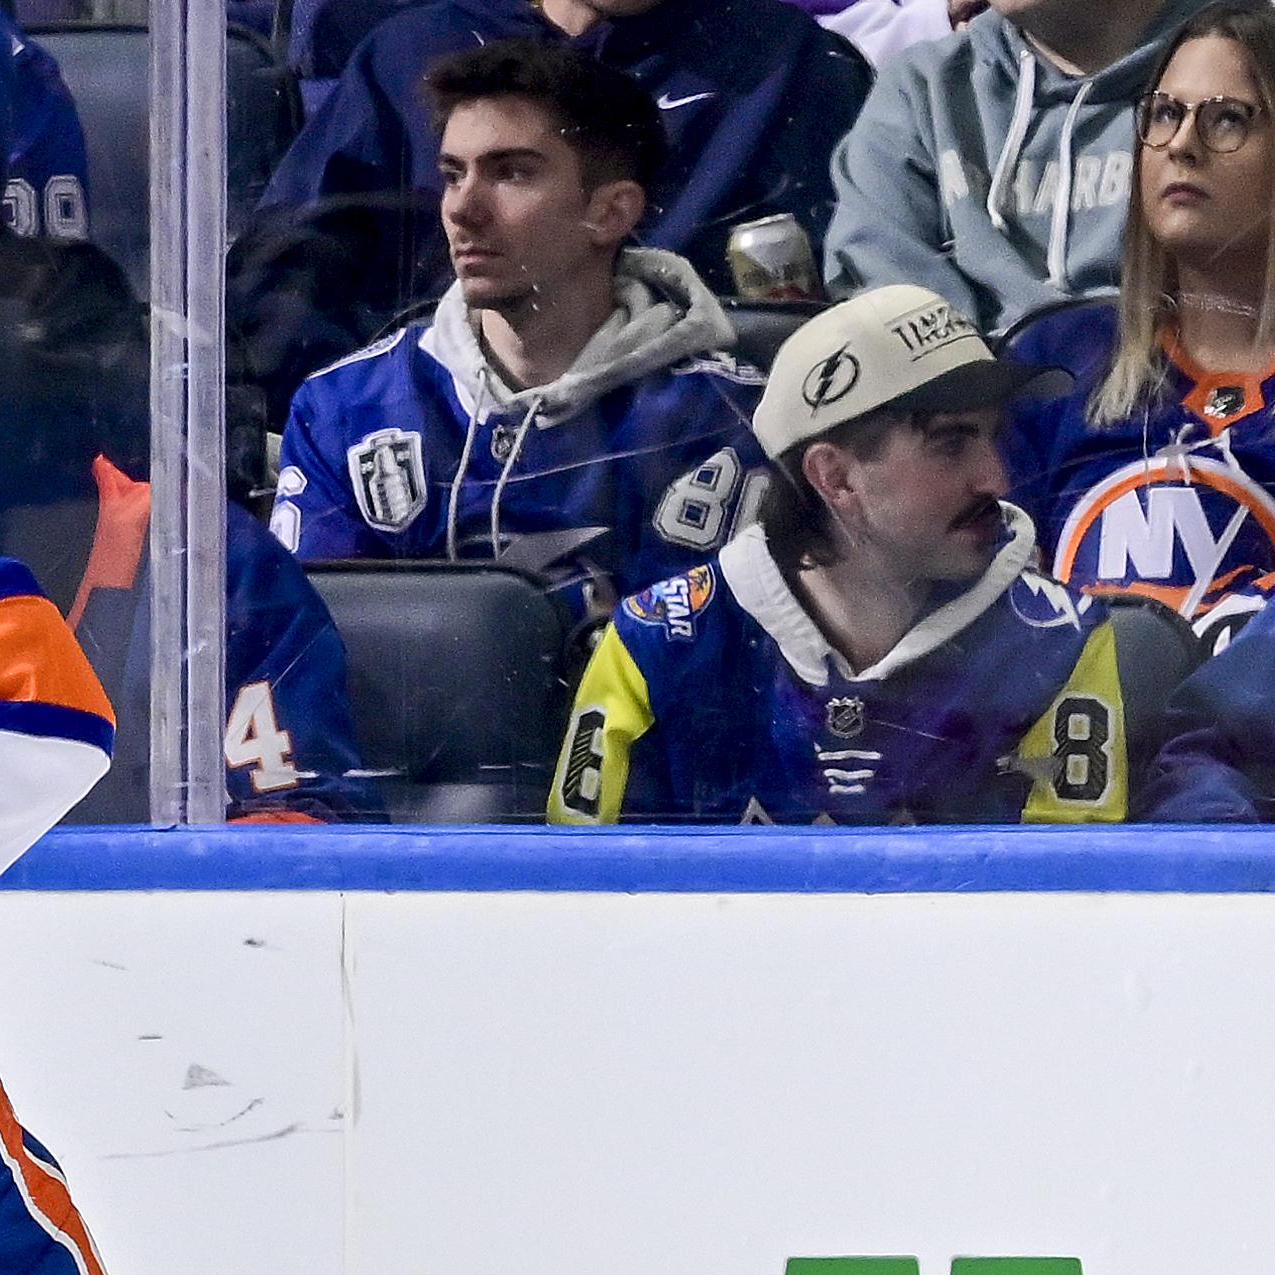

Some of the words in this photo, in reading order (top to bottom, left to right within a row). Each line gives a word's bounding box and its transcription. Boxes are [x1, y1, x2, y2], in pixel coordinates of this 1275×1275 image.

[1098, 487, 1249, 621] NY
[224, 680, 299, 793] 4
[1052, 691, 1117, 808] 8
